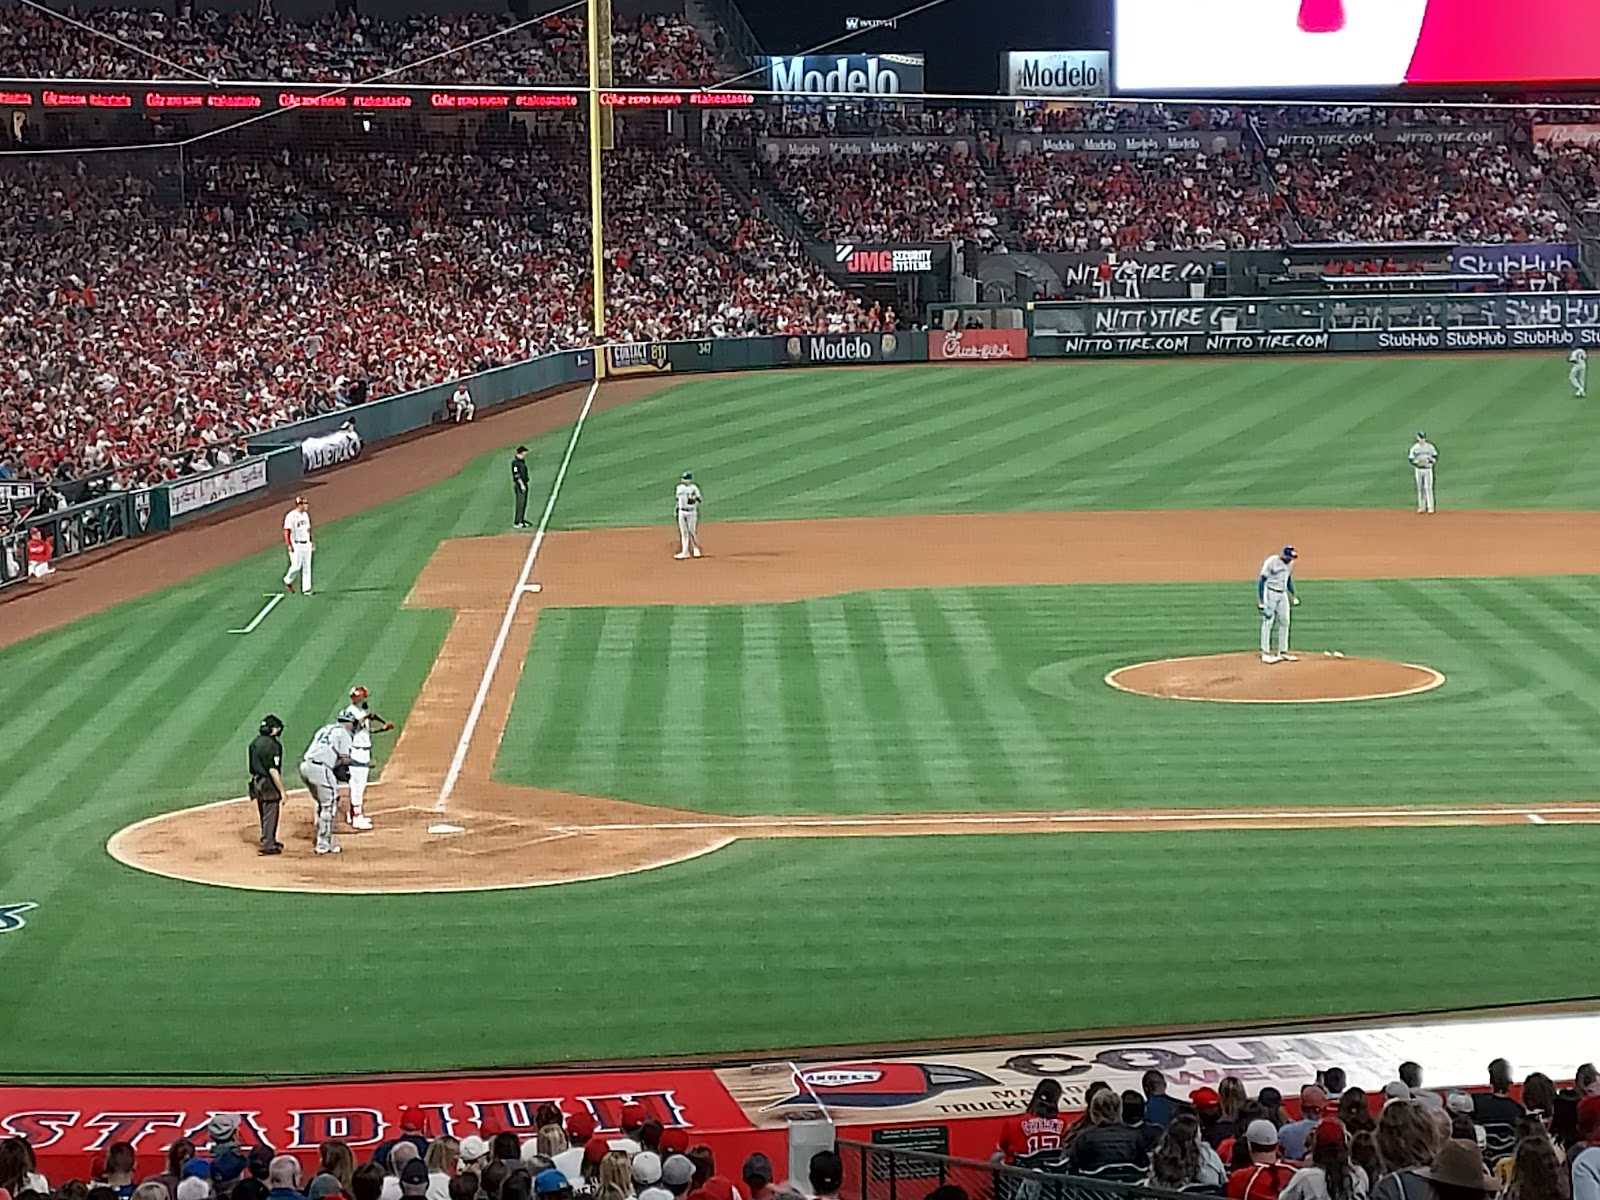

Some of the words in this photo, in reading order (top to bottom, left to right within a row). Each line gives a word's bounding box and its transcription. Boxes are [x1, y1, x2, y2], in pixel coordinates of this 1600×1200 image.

[771, 57, 898, 95] Modelo
[1023, 60, 1096, 88] Modelo
[847, 251, 893, 273] JMG
[893, 250, 932, 260] SECURITY
[893, 261, 932, 271] SYSTEMS
[1065, 338, 1113, 352] NITTO
[1116, 336, 1188, 351] TIRE.COM
[1206, 335, 1253, 350] NITTO
[1257, 333, 1329, 349] TIRE.COM
[1379, 333, 1439, 346] StubHub
[1446, 332, 1506, 345] StubHub
[1513, 330, 1573, 344] StubHub
[810, 337, 871, 360] Modelo
